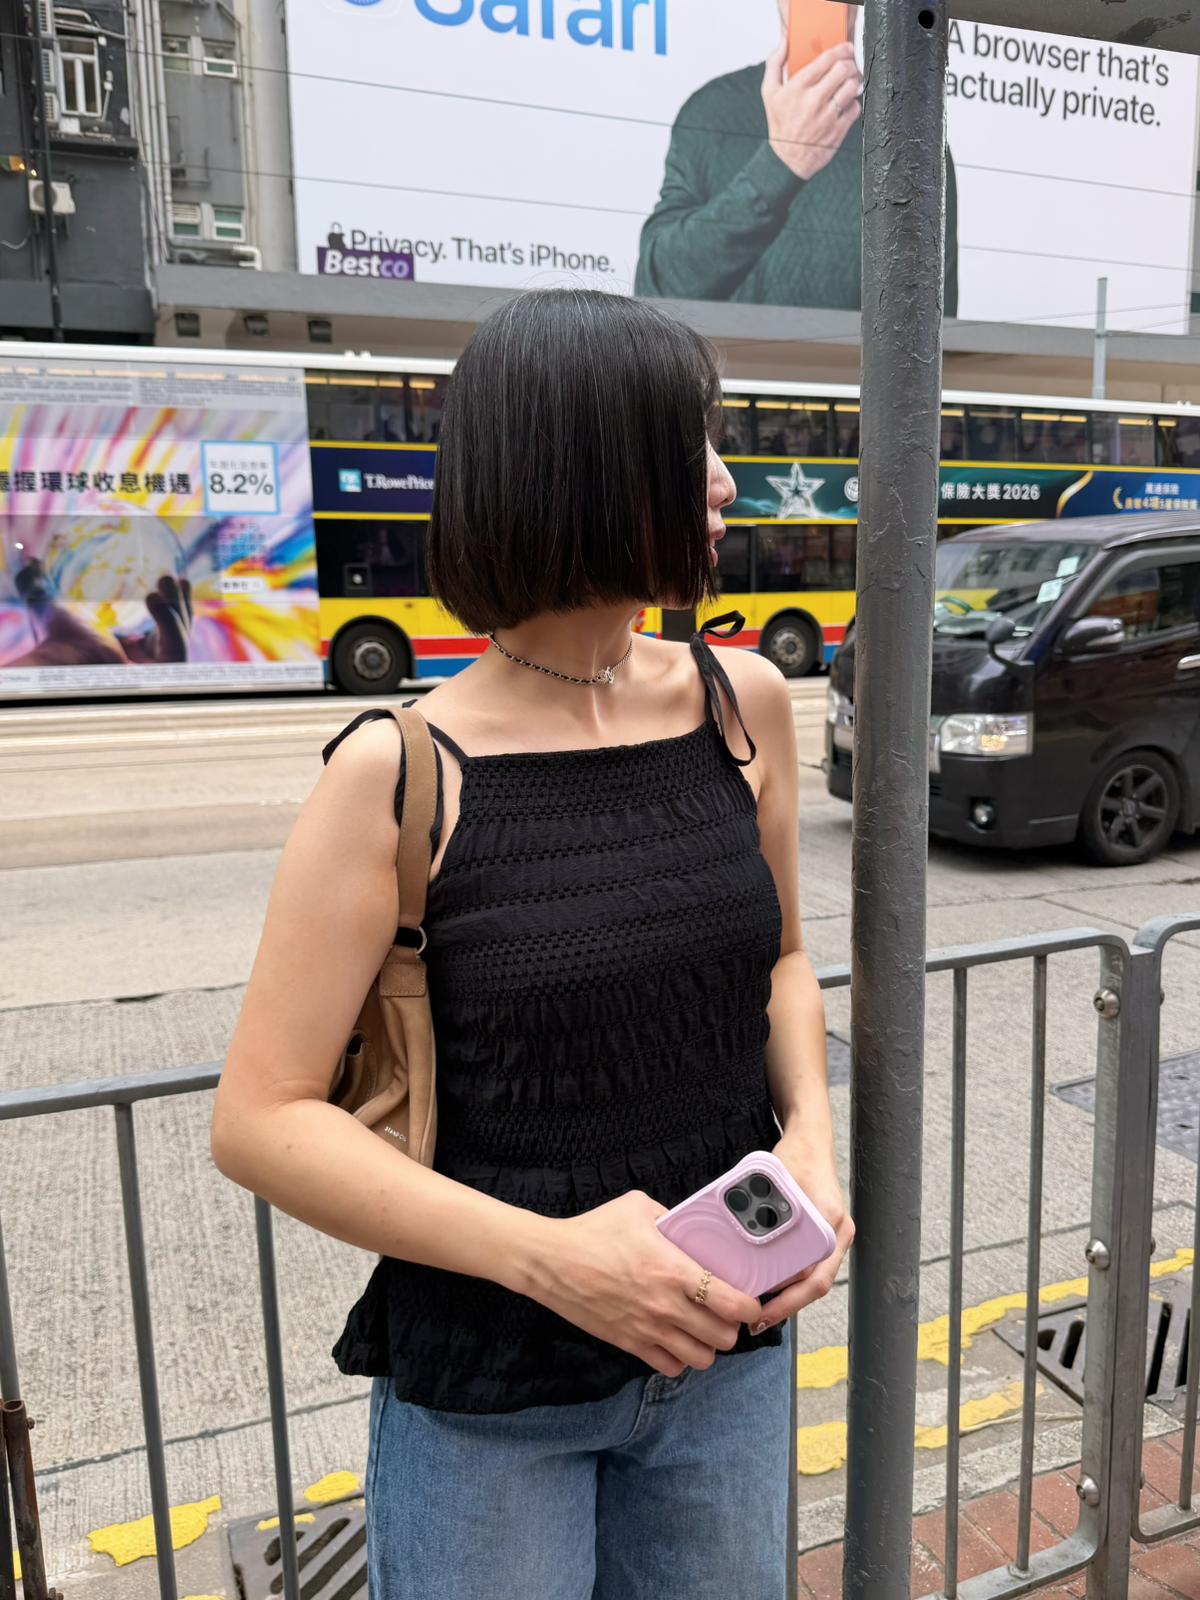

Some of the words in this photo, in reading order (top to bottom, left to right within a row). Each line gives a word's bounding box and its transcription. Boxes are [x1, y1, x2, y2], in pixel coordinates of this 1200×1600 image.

[947, 20, 965, 54] A
[974, 23, 1091, 73] browser
[1097, 46, 1169, 87] that's
[946, 71, 1057, 118] actually
[1063, 85, 1161, 128] private.
[324, 248, 410, 278] Bestco
[351, 229, 447, 263] Privacy.
[451, 236, 525, 266] That's
[530, 243, 616, 274] iPhone.
[210, 472, 274, 496] 8.2%
[1002, 483, 1041, 501] 2026
